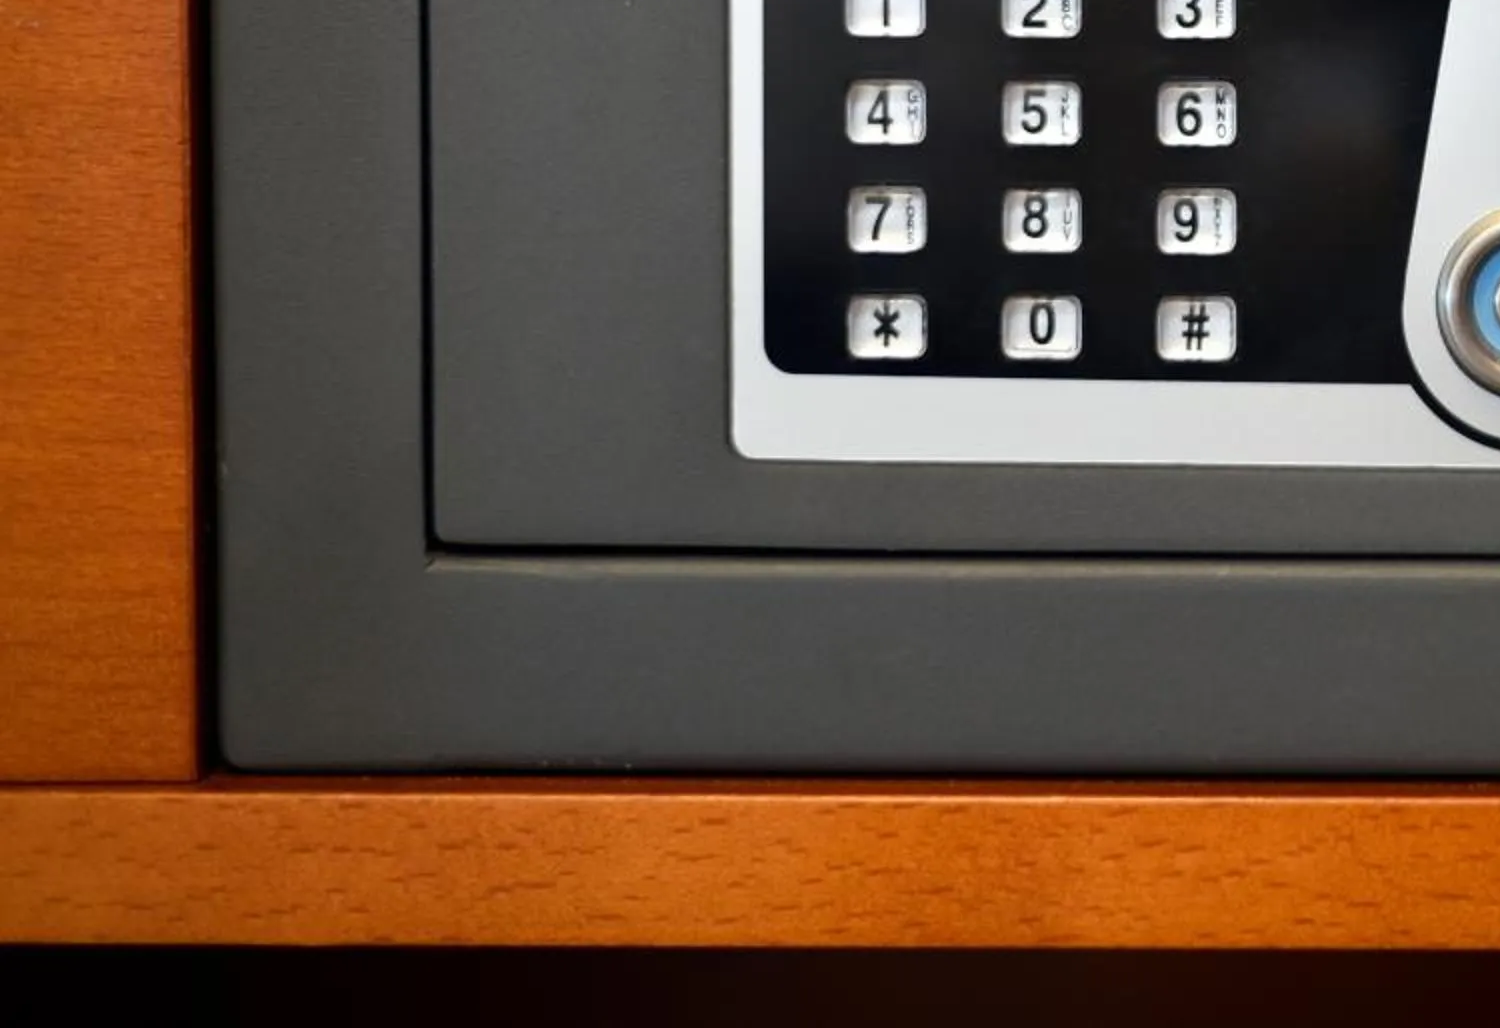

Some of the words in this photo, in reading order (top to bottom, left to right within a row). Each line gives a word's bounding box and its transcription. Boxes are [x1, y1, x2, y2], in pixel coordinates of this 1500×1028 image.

[867, 89, 893, 134] 4
[1021, 89, 1048, 134] 5
[1176, 91, 1202, 136] 6
[865, 196, 892, 241] 7
[1022, 194, 1048, 238] 8
[1173, 198, 1199, 242] 9
[1029, 303, 1056, 345] 0
[1181, 304, 1210, 351] #
